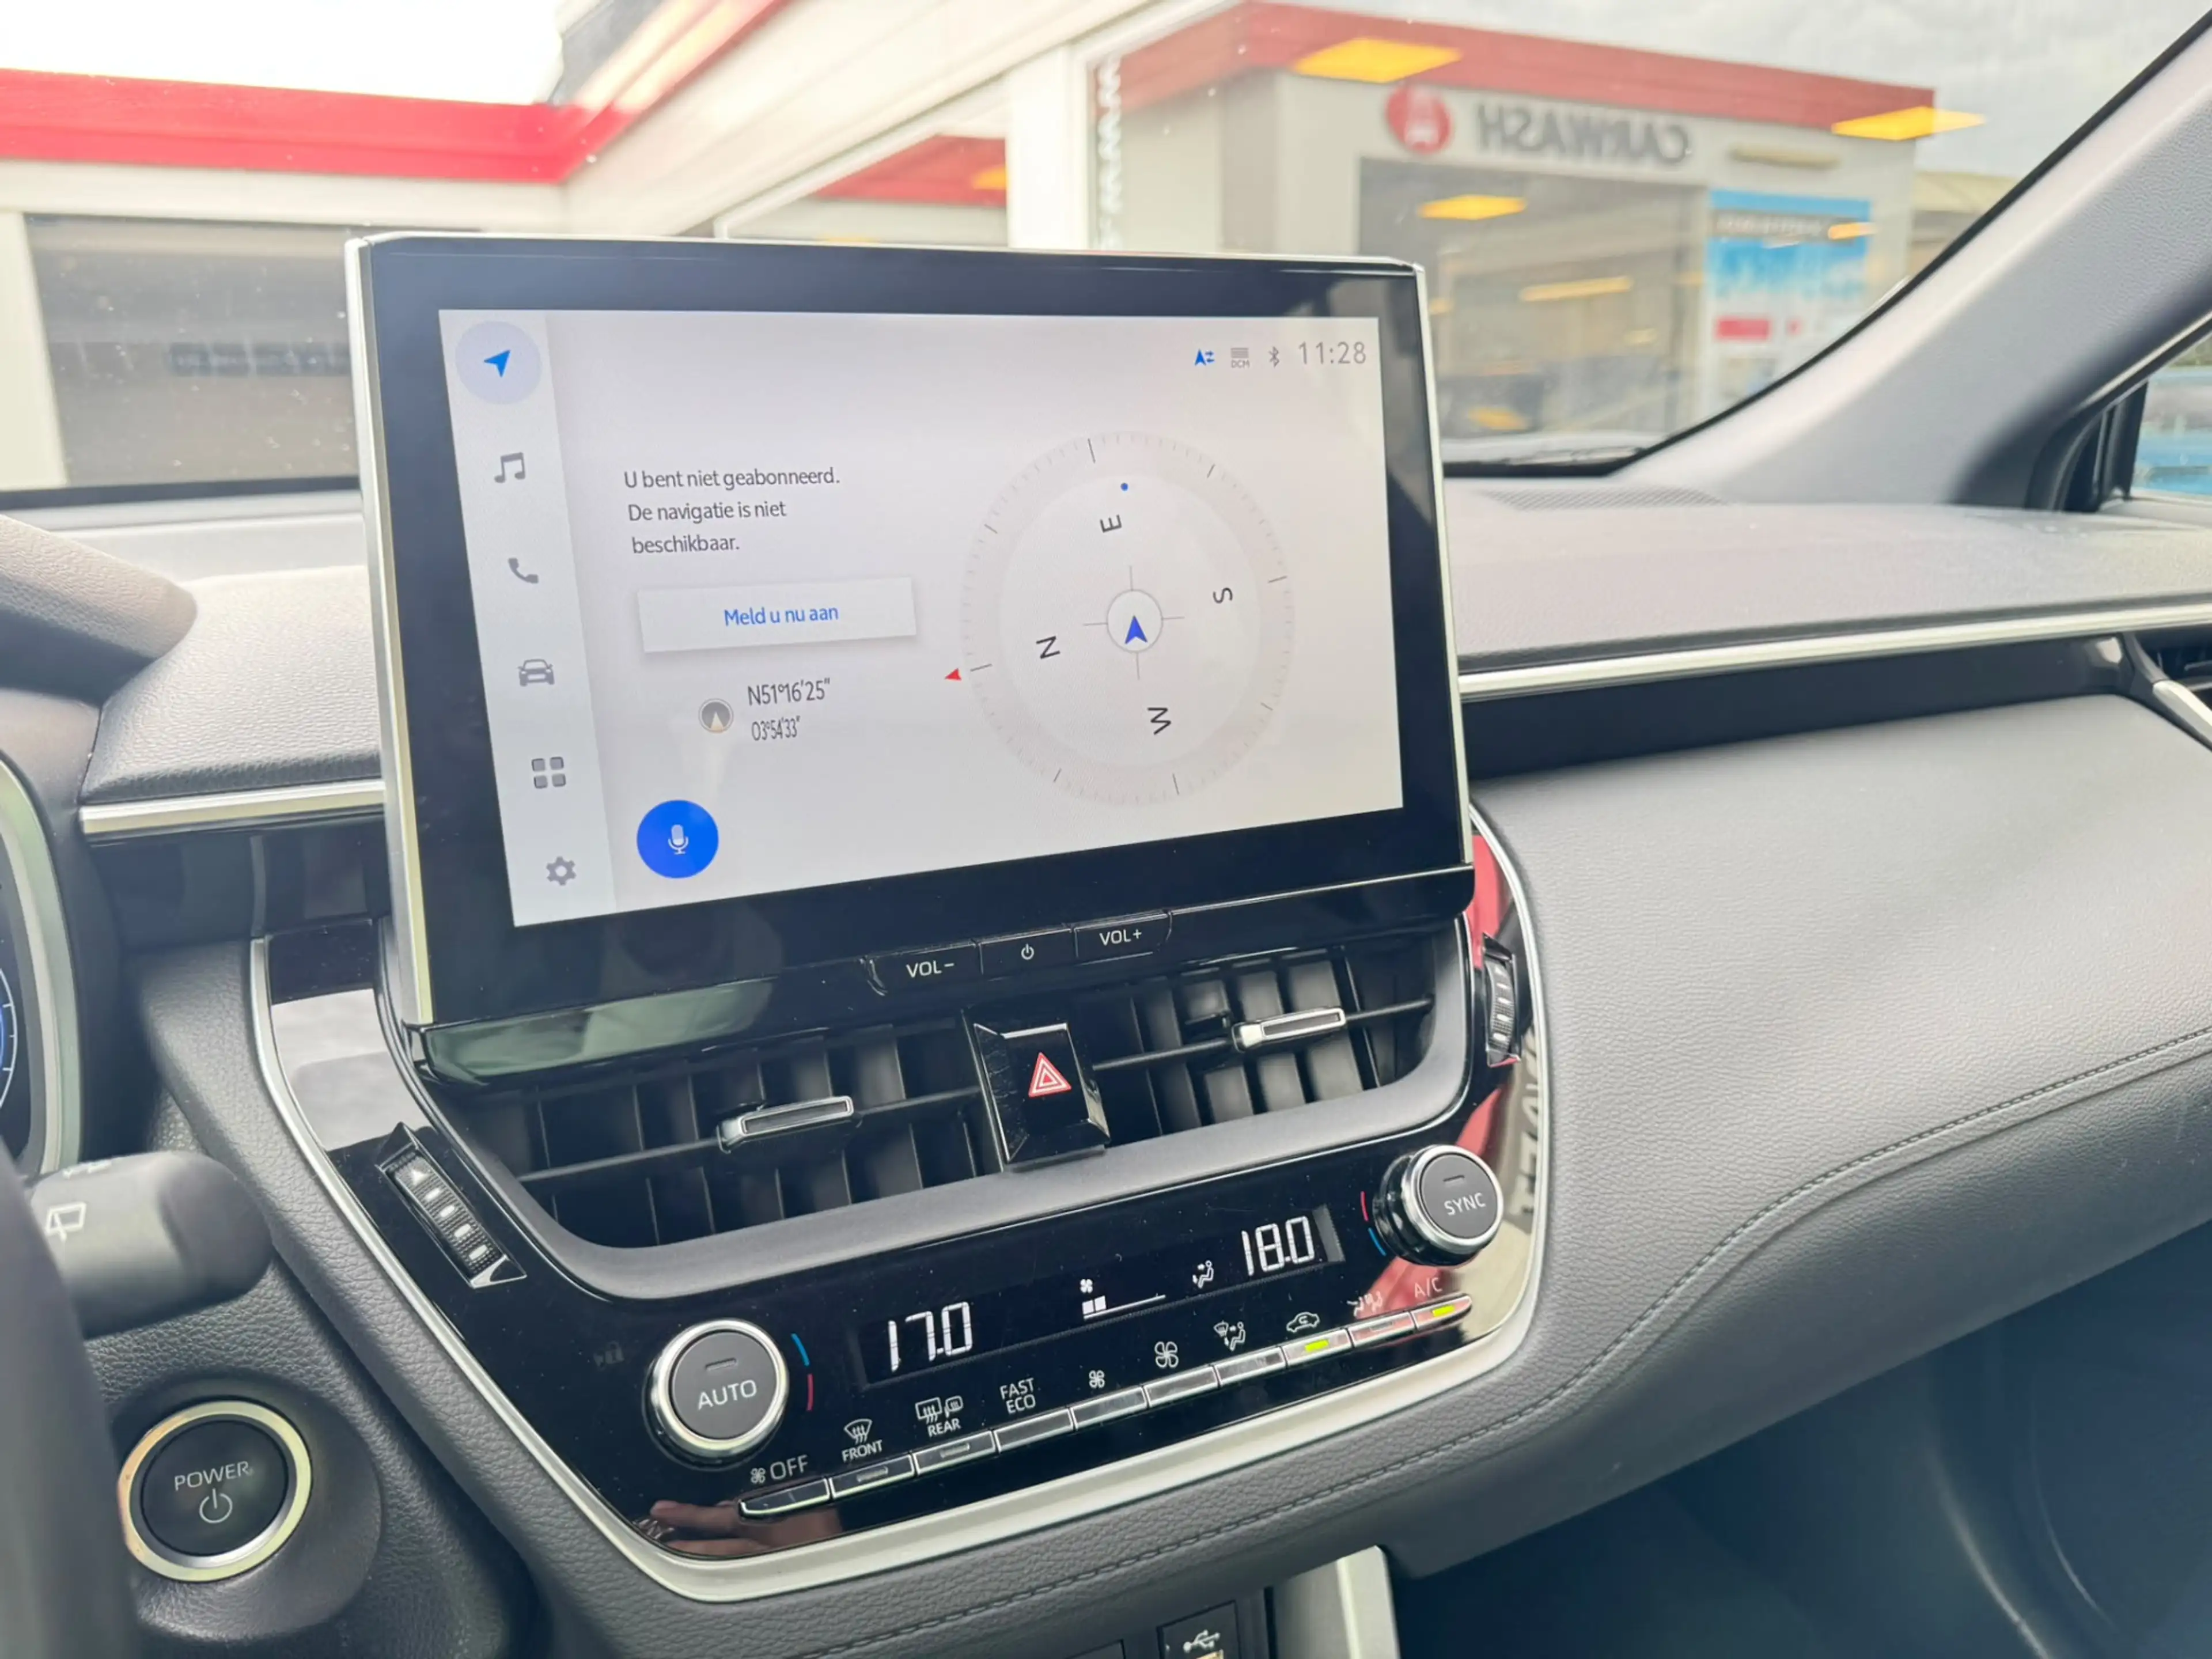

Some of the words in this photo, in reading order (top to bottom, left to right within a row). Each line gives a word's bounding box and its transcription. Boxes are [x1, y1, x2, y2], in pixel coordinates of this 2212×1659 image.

[1230, 359, 1250, 368] DCM
[1298, 341, 1366, 365] 11:28
[624, 471, 638, 488] U
[642, 469, 684, 488] bent
[687, 469, 721, 487] niet
[724, 467, 840, 490] geabonneerd.
[628, 504, 653, 521] De
[657, 502, 734, 524] navigatie
[738, 502, 751, 518] is
[755, 501, 786, 517] niet
[1099, 514, 1123, 533] E
[632, 534, 740, 554] beschikbaar.
[1213, 586, 1233, 604] S
[724, 607, 766, 627] Meld
[770, 610, 781, 624] u
[785, 609, 805, 623] nu
[809, 607, 839, 622] aan
[1036, 635, 1060, 660] N
[1444, 1192, 1486, 1216] SYNC
[1241, 1215, 1315, 1277] 18.0
[1414, 1277, 1443, 1298] A/C
[887, 1301, 973, 1373] 17.0
[697, 1379, 757, 1411] AUTO
[999, 1377, 1035, 1399] FAST
[1006, 1394, 1036, 1414] ECO
[927, 1418, 961, 1438] REAR
[841, 1439, 884, 1463] FRONT
[174, 1460, 250, 1491] POWER
[770, 1455, 809, 1482] OFF
